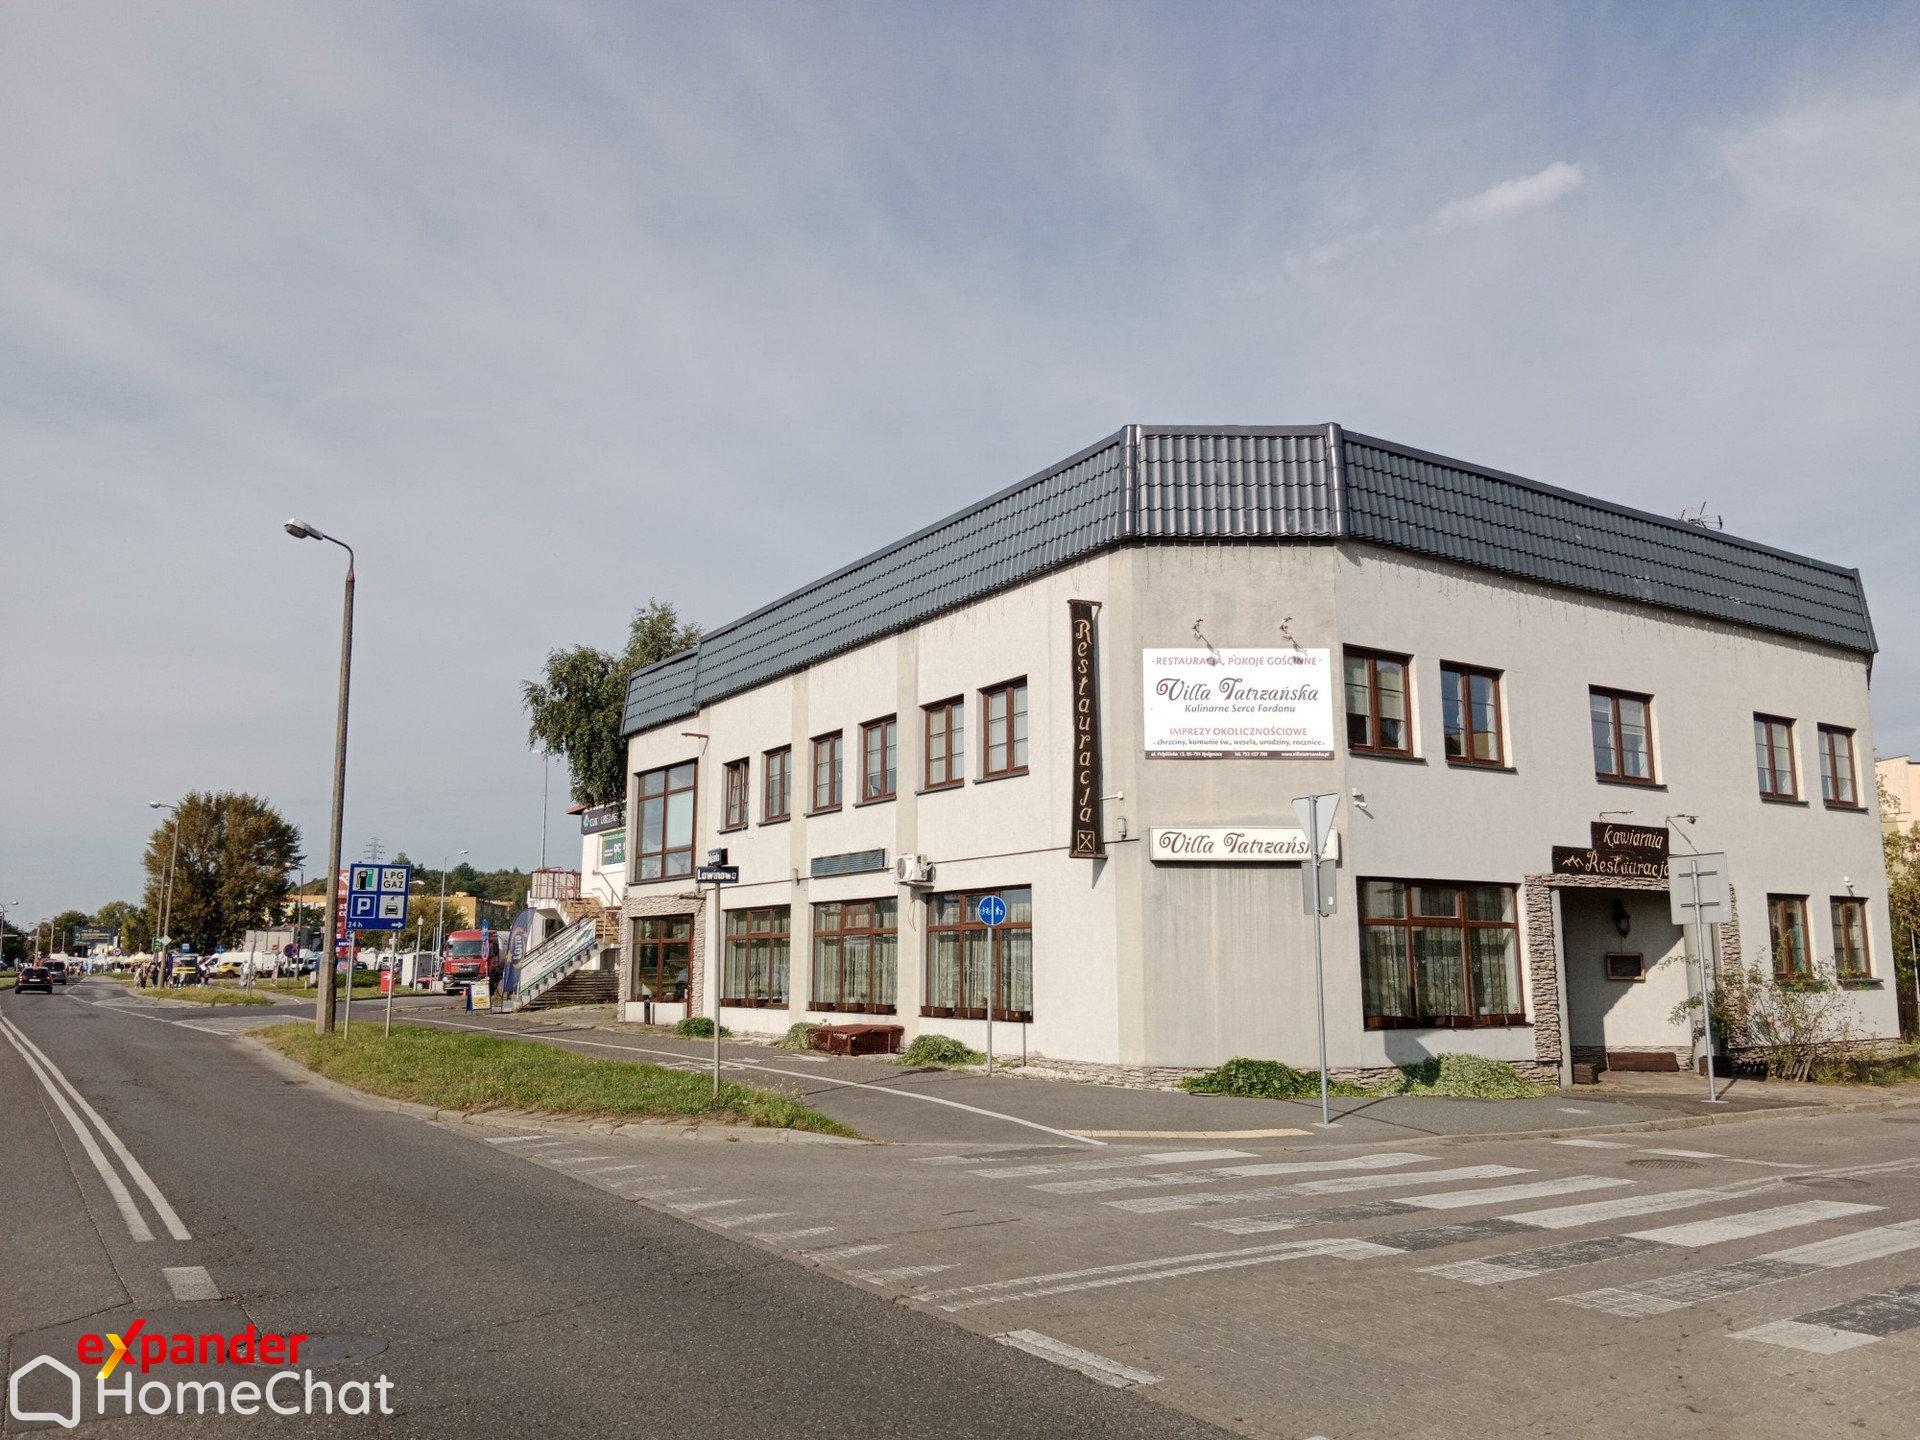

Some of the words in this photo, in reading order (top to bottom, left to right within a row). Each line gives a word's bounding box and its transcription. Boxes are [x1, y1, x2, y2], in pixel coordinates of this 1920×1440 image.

[1228, 656, 1264, 667] POKOJE
[1156, 677, 1211, 701] Villa
[1219, 677, 1319, 701] Tatrzańska
[1185, 704, 1229, 713] Kulinarne
[1231, 704, 1255, 713] Serce
[1257, 704, 1296, 713] Fordonu
[1073, 619, 1093, 822] Restauracja
[1169, 727, 1211, 736] IMPREZY
[1213, 725, 1308, 736] OKOLICZNOŚCIOWE
[1188, 738, 1219, 746] komunie
[1159, 831, 1214, 854] Villa
[1223, 832, 1327, 854] Tatrzańs
[1603, 825, 1664, 850] Kawiarnia
[384, 871, 404, 879] LPG
[383, 881, 403, 889] GAZ
[356, 898, 371, 915] P
